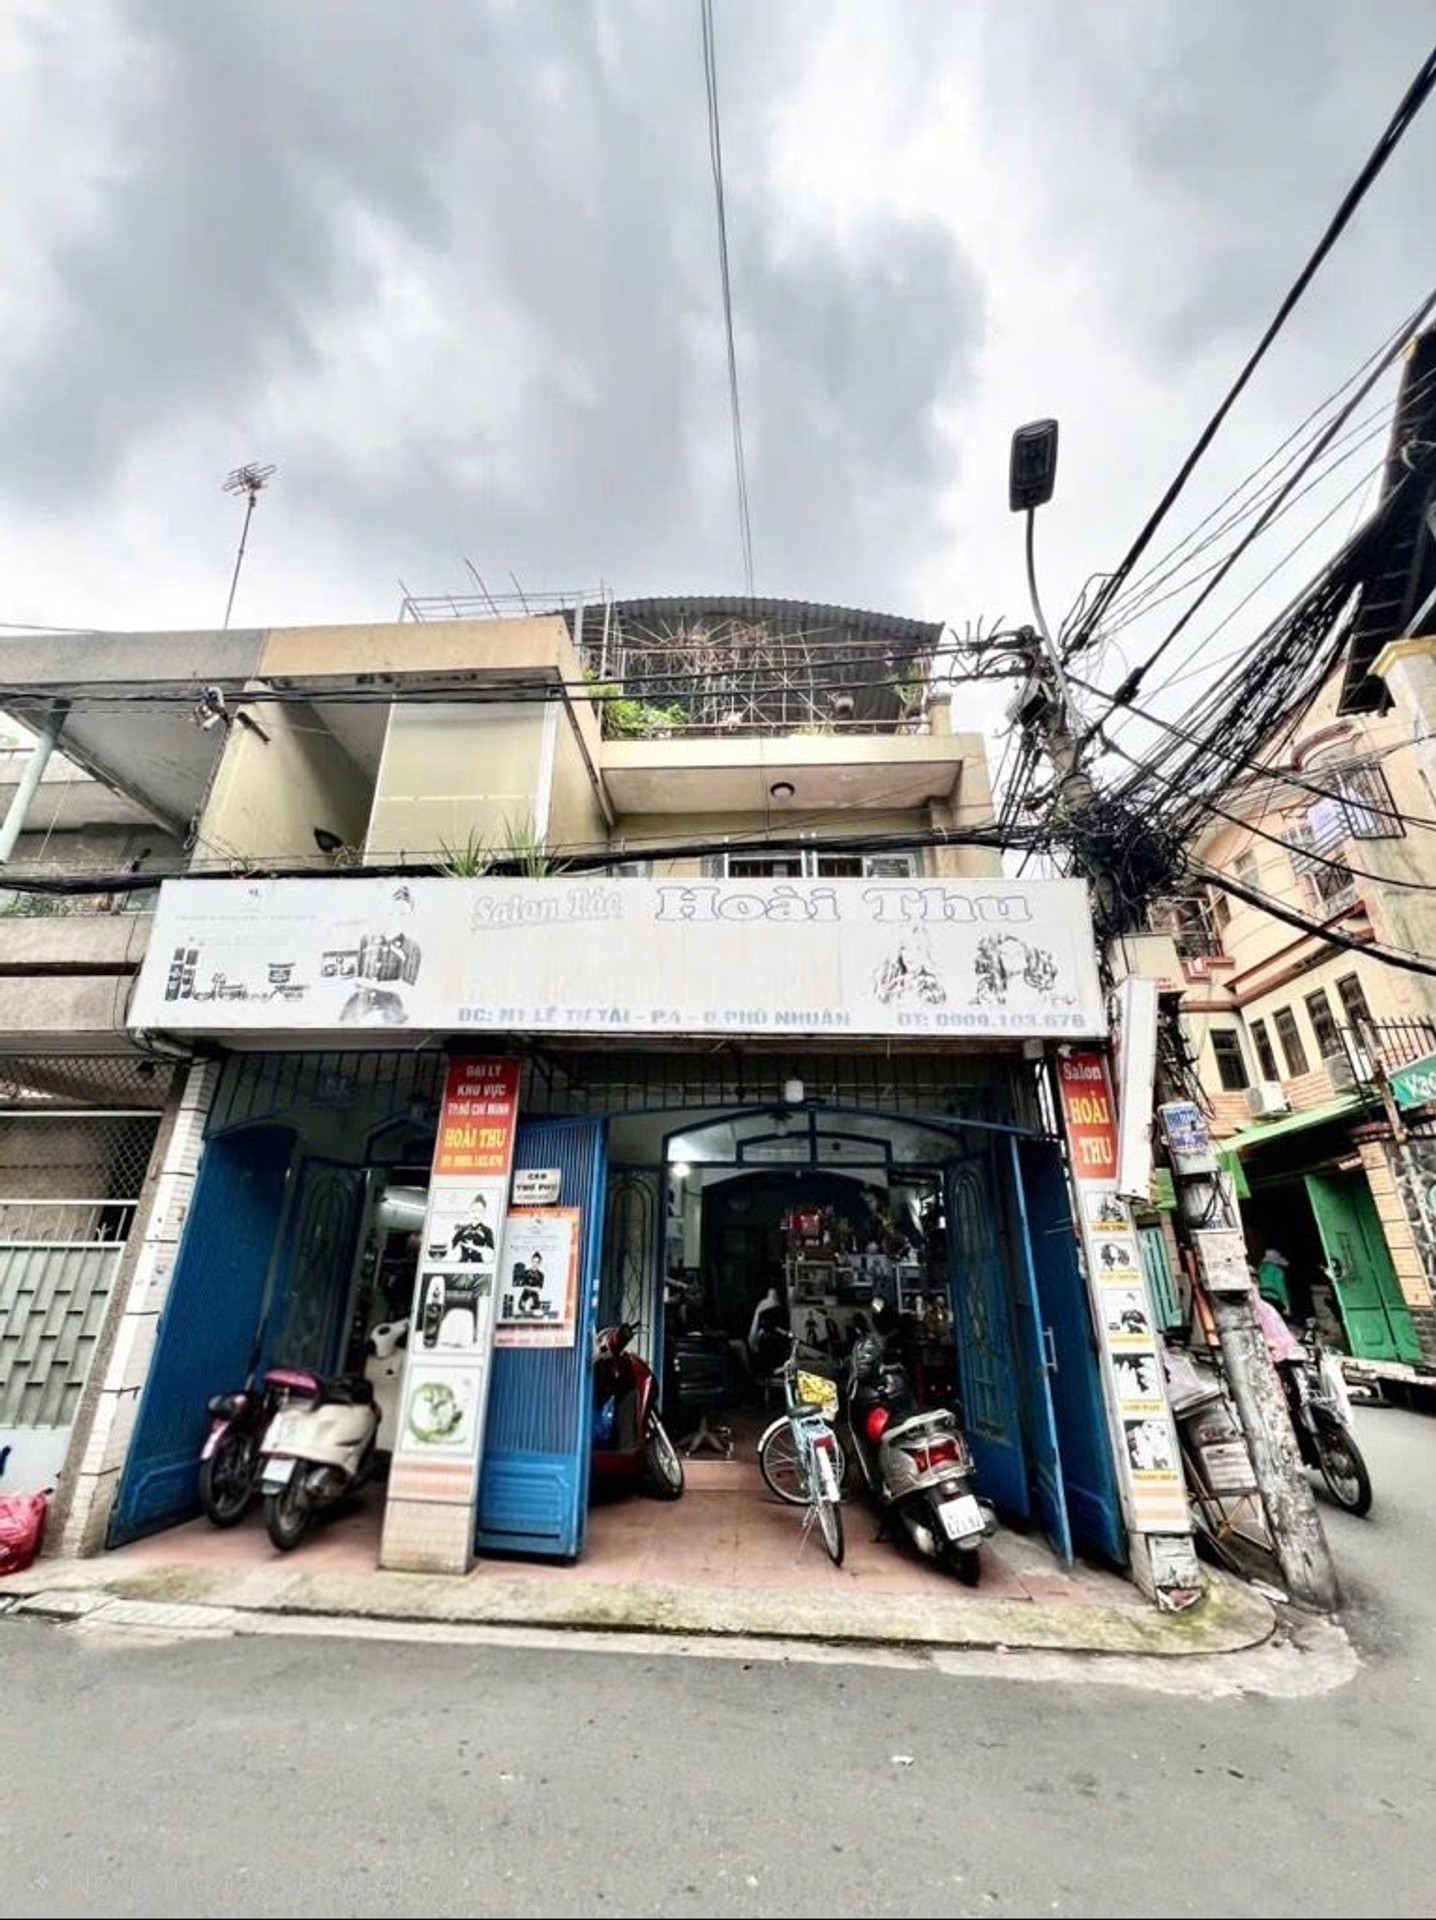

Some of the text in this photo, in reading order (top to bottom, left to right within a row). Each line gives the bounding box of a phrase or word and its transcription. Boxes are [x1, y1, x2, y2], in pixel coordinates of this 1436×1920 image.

[469, 895, 560, 928] Salon
[655, 887, 1034, 923] Hoài Thu
[1063, 1062, 1102, 1080] Salon
[479, 1128, 506, 1147] THU
[1080, 1137, 1113, 1166] THU
